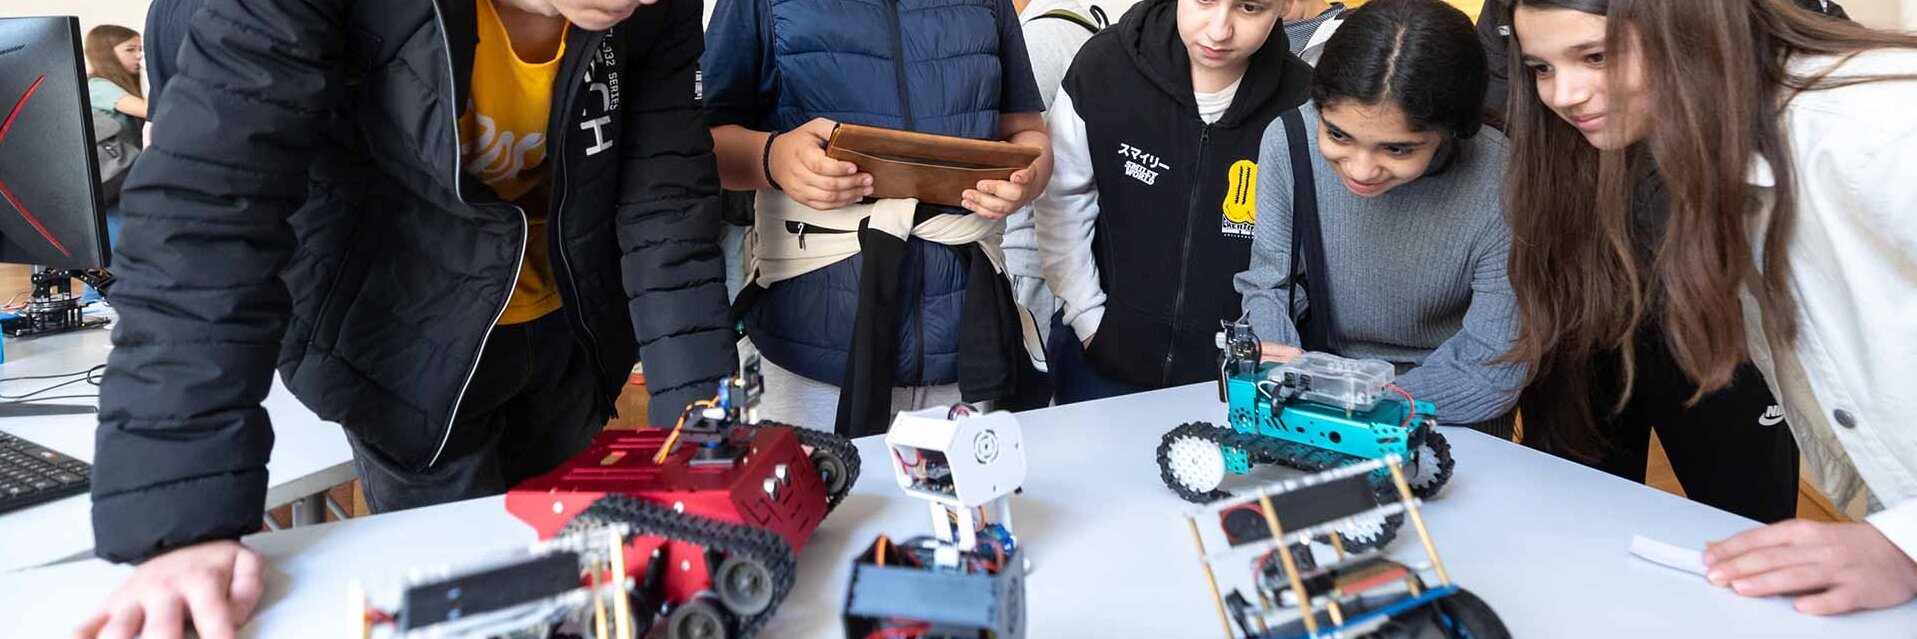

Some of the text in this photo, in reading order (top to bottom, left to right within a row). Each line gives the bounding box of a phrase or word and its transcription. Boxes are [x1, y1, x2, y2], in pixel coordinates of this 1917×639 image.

[608, 72, 620, 111] SERIES
[1117, 142, 1170, 171] スマイリー
[1124, 160, 1158, 180] SMILEY
[1125, 167, 1155, 186] WORLD
